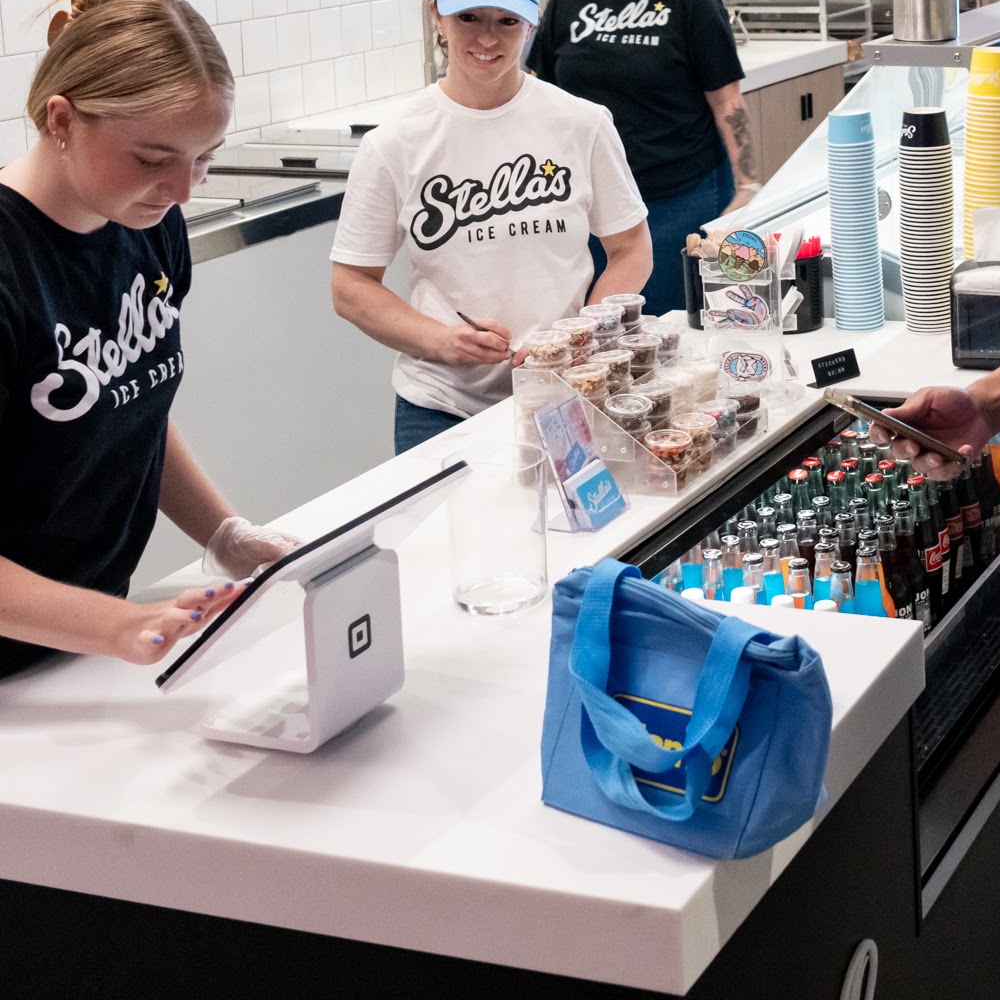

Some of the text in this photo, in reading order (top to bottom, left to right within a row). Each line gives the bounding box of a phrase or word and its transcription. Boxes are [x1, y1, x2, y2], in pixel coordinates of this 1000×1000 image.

[596, 33, 660, 46] ICE CREAM
[410, 154, 571, 251] Stella's
[468, 219, 567, 243] ICE CREAM
[817, 356, 846, 369] STICKERS
[111, 379, 140, 409] ICE
